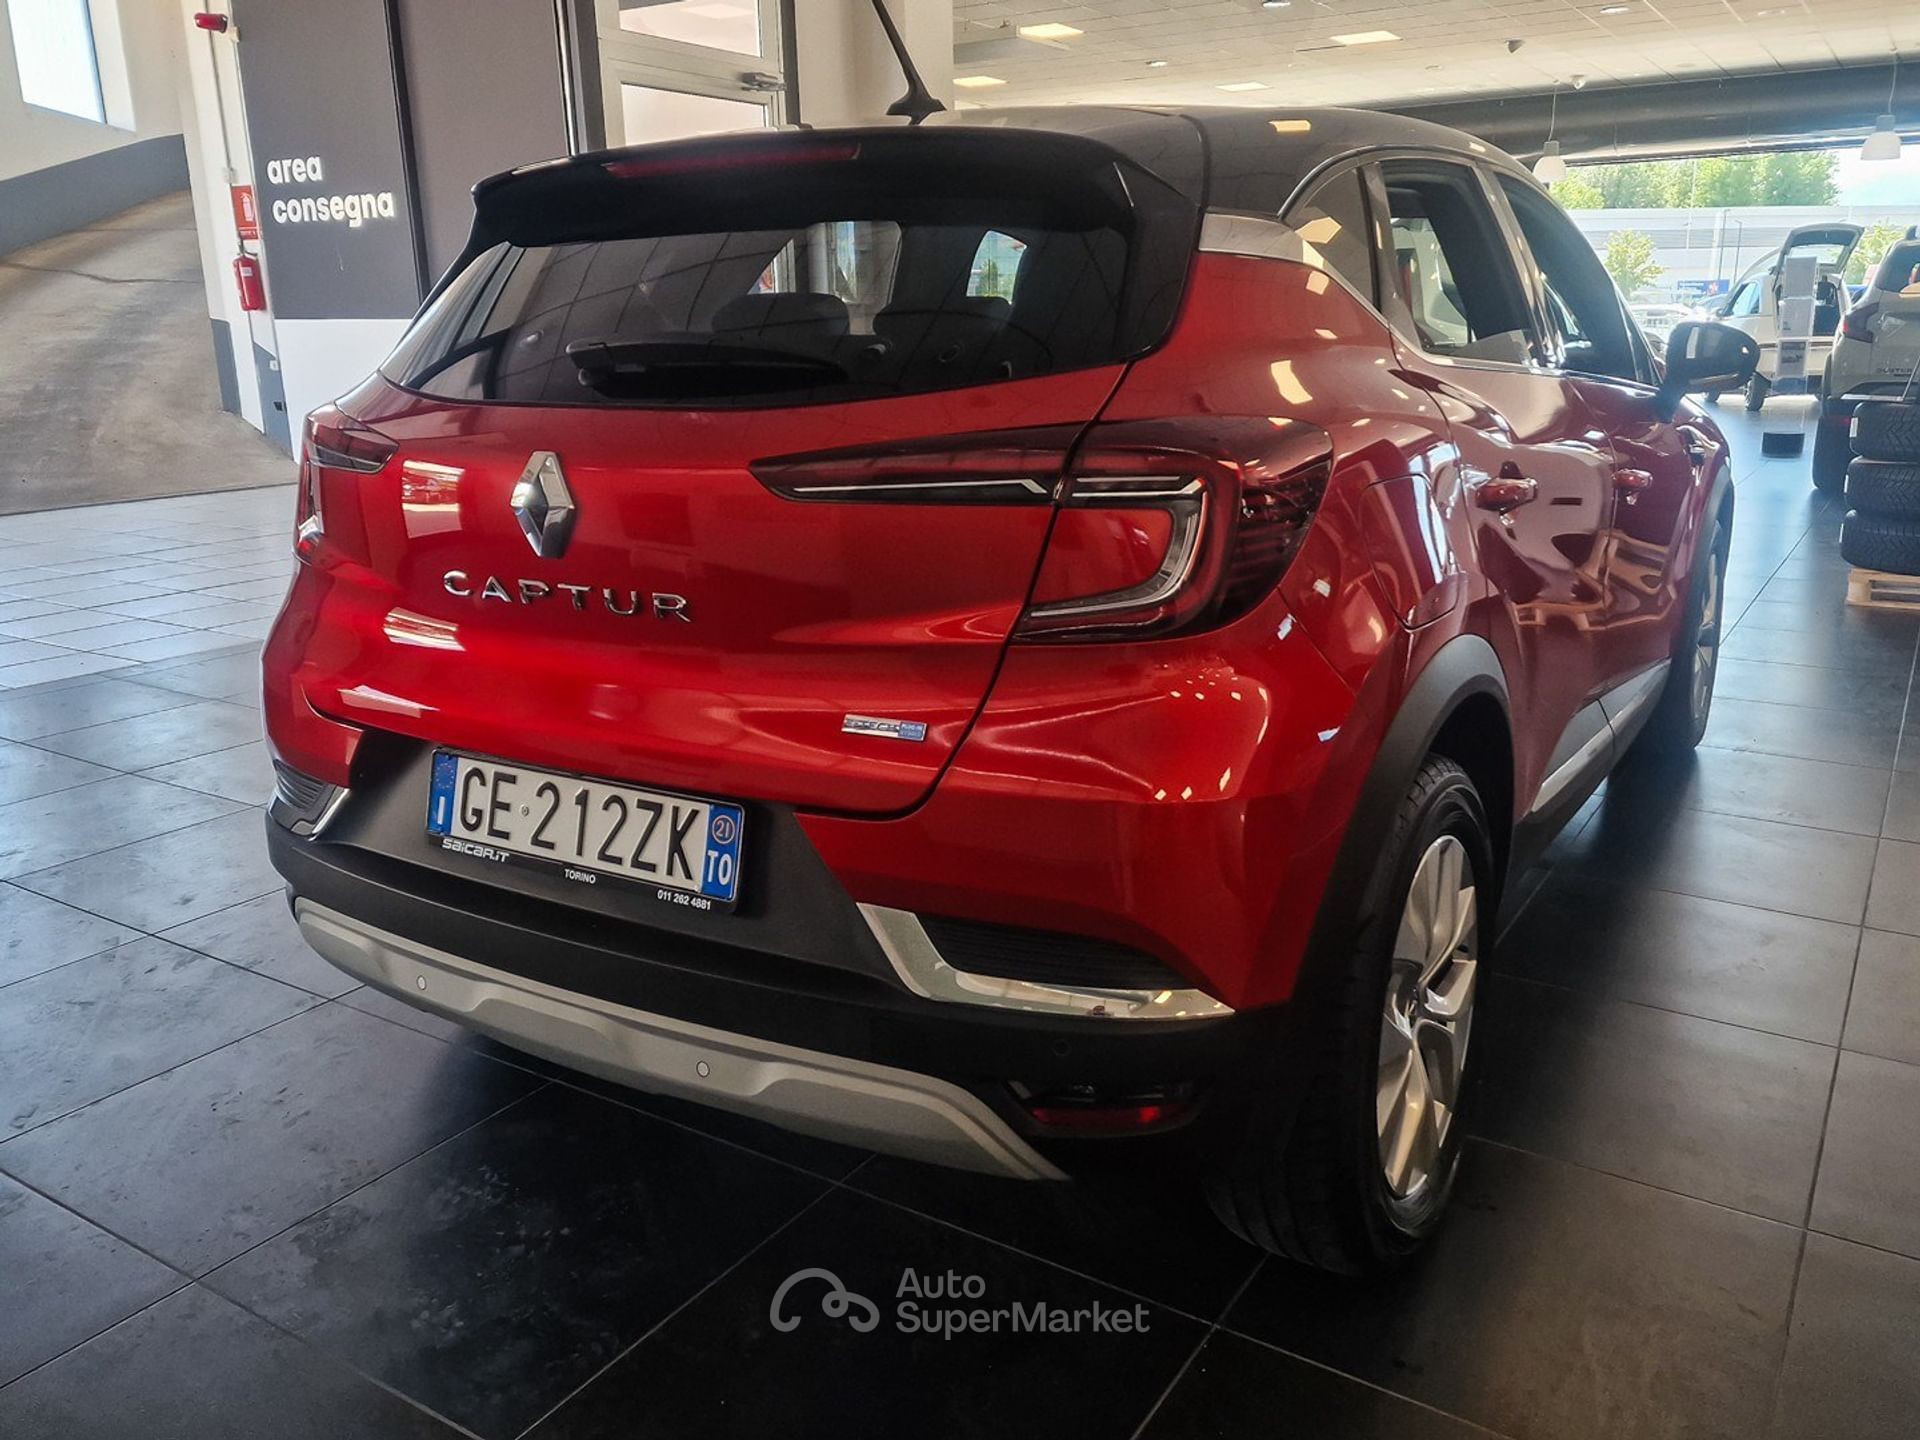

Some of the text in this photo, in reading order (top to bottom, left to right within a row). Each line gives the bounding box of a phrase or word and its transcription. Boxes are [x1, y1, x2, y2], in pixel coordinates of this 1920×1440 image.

[267, 156, 323, 184] area
[272, 191, 395, 228] consegna
[443, 570, 691, 623] CAPTUR
[715, 820, 731, 839] 21
[564, 868, 596, 884] TORINO
[707, 849, 732, 886] TO
[657, 889, 672, 902] 011
[673, 894, 690, 906] 262
